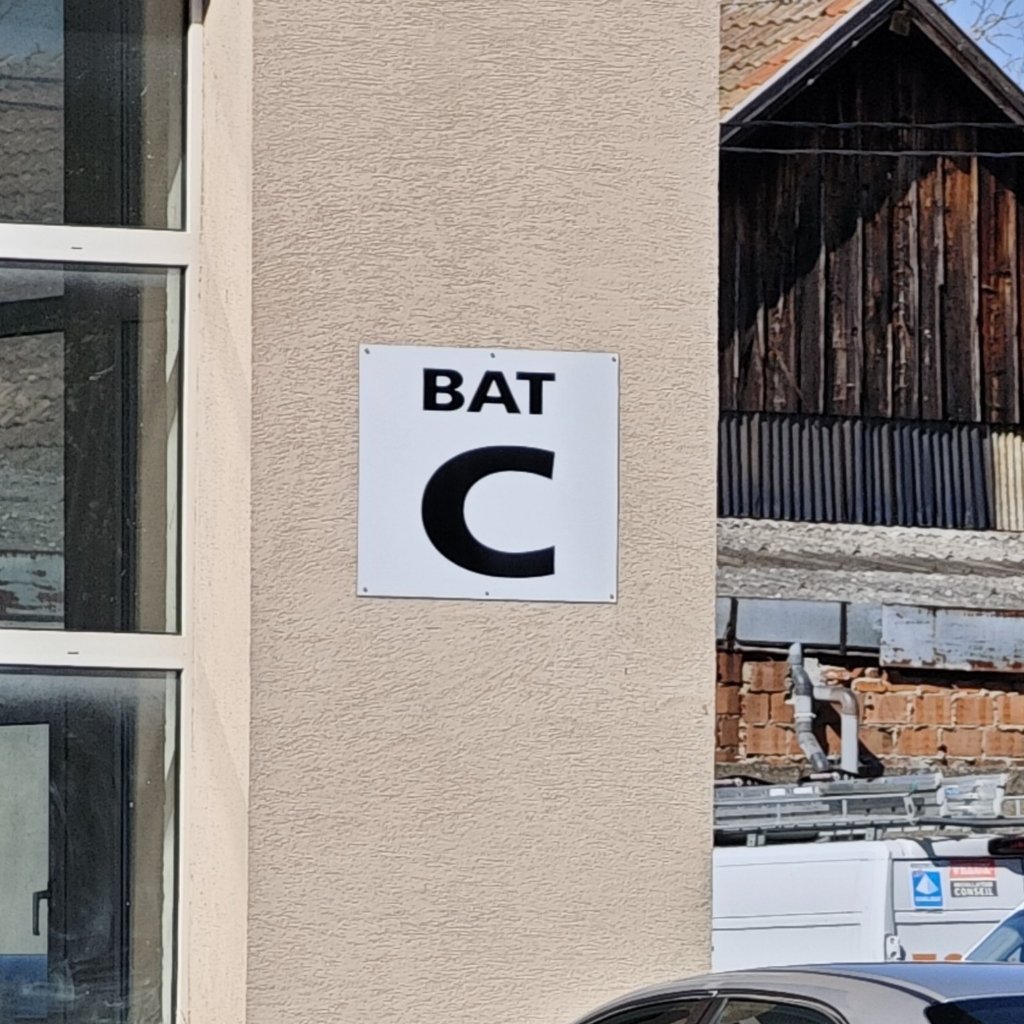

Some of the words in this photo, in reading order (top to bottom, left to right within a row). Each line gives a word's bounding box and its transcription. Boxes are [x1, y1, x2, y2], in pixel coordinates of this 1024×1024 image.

[423, 368, 556, 415] BAT
[422, 445, 555, 579] C
[953, 887, 994, 896] CONSEIL
